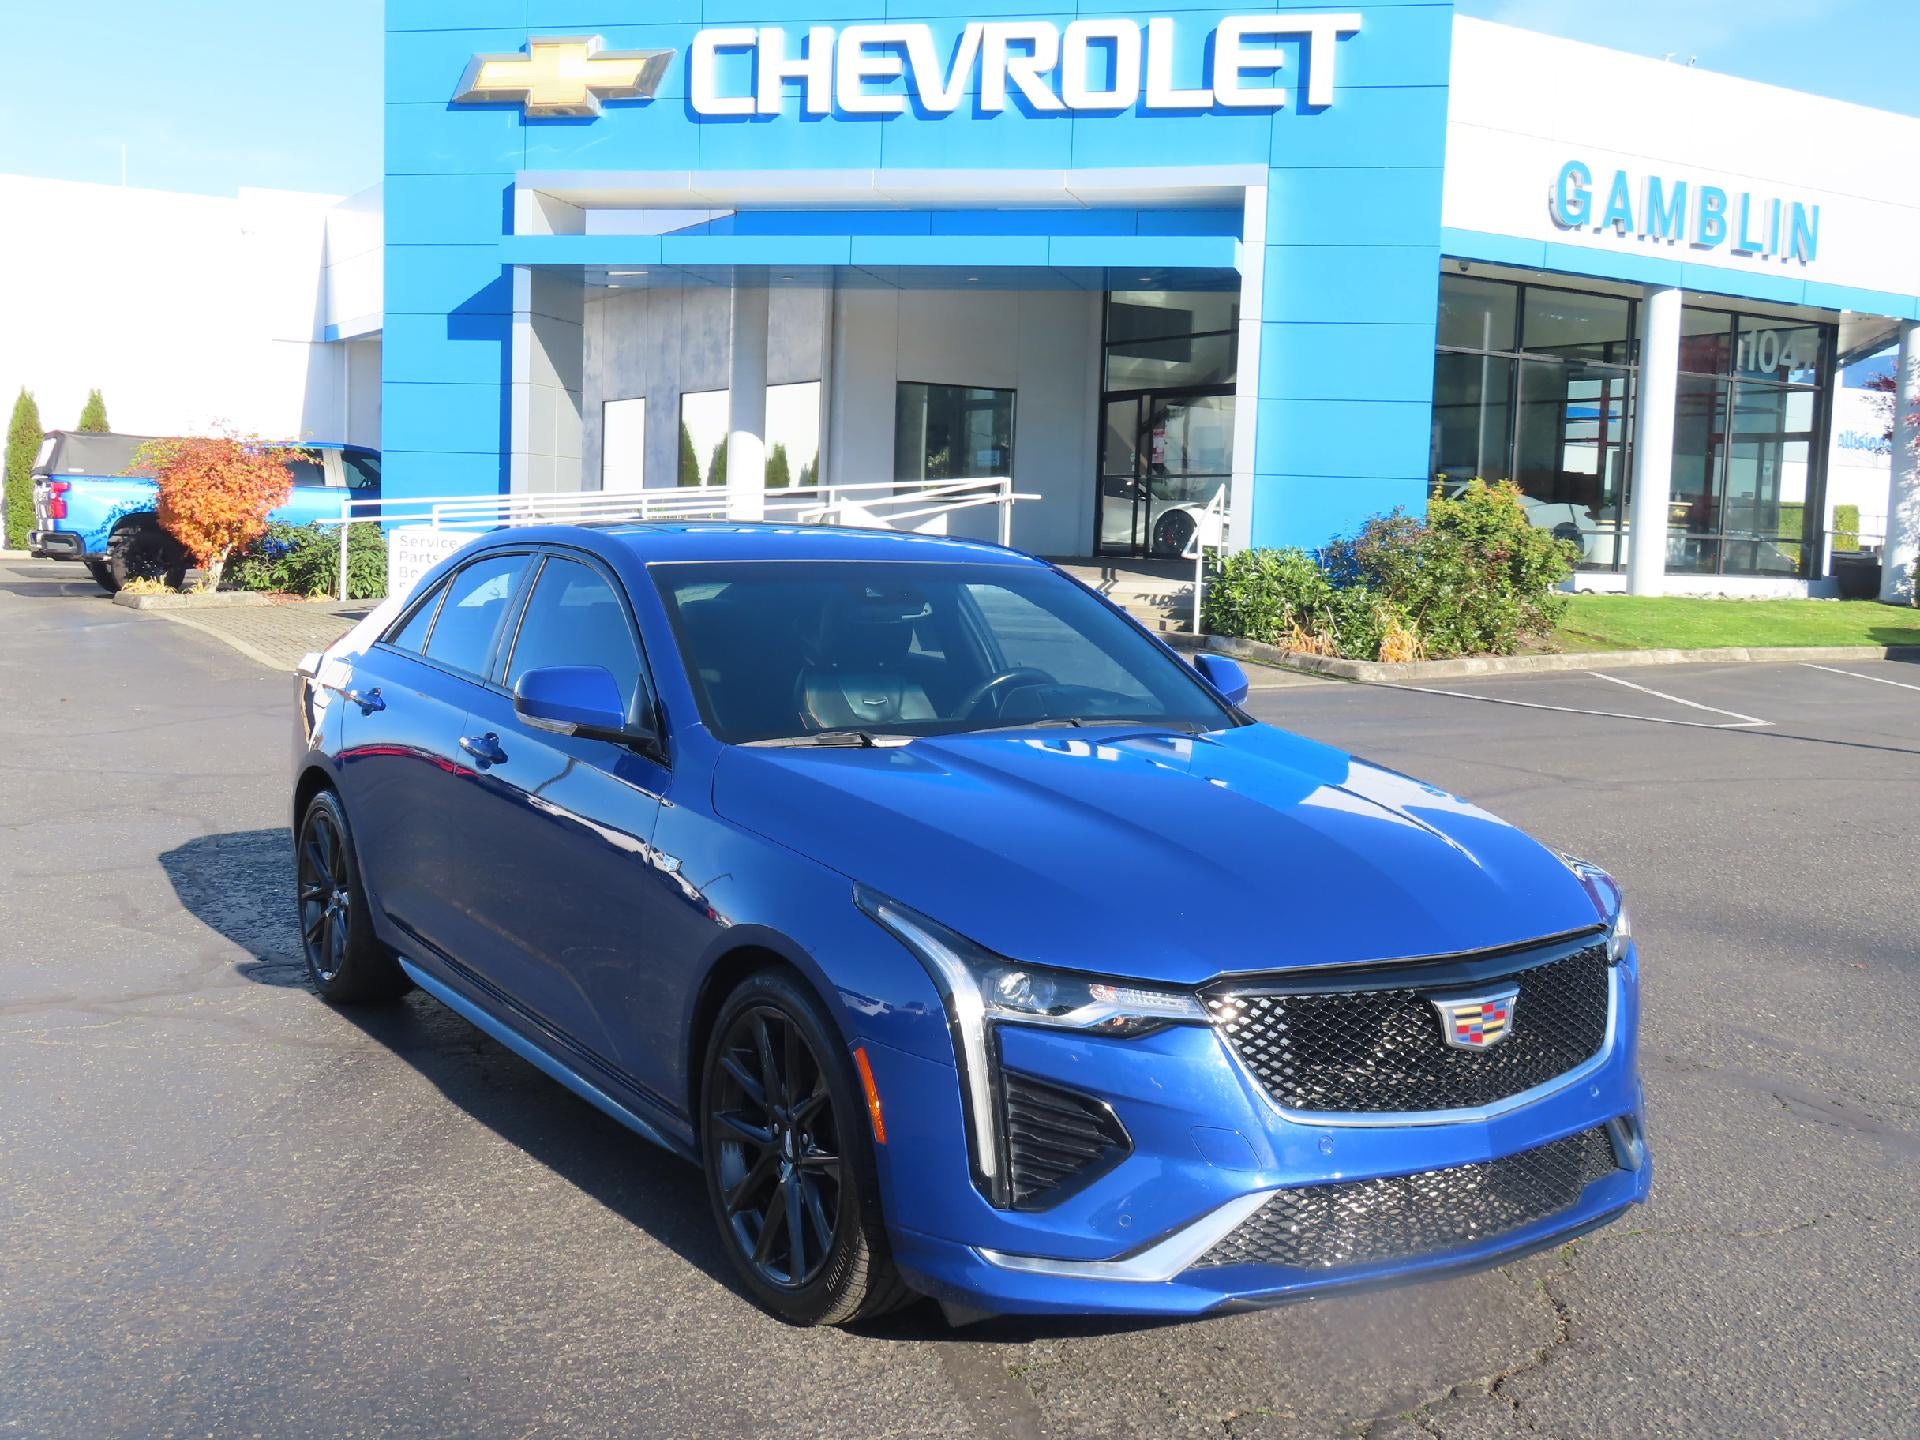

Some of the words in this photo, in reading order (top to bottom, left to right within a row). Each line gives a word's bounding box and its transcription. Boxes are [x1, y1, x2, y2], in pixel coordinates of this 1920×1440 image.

[690, 13, 1362, 115] CHEVROLET
[1550, 160, 1820, 264] GAMBLIN
[399, 535, 458, 549] Service
[399, 550, 440, 564] Parts
